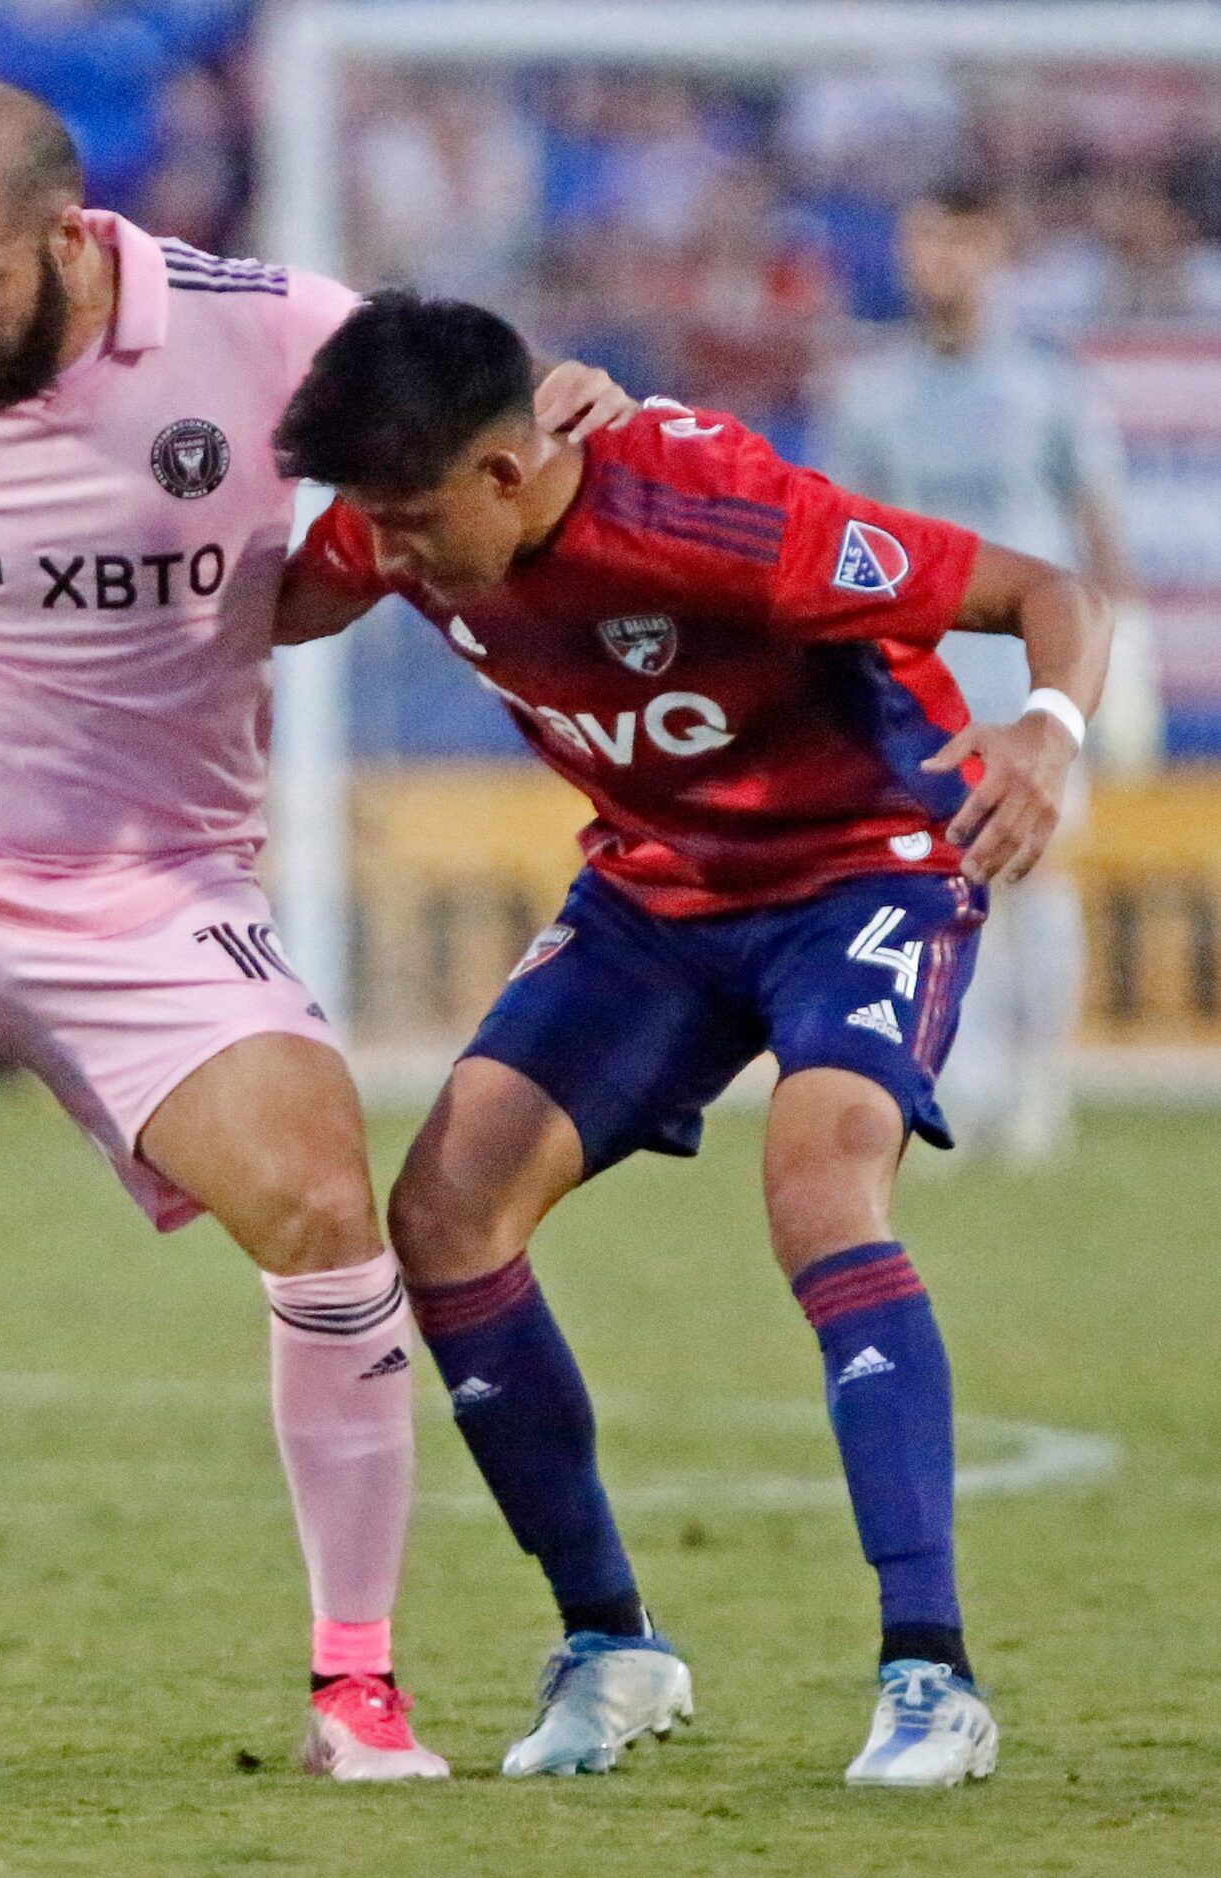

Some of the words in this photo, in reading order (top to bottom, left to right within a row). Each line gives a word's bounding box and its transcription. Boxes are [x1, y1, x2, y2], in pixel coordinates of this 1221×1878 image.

[39, 543, 226, 610] XBTO
[840, 546, 863, 582] MLS
[847, 905, 924, 1001] 4
